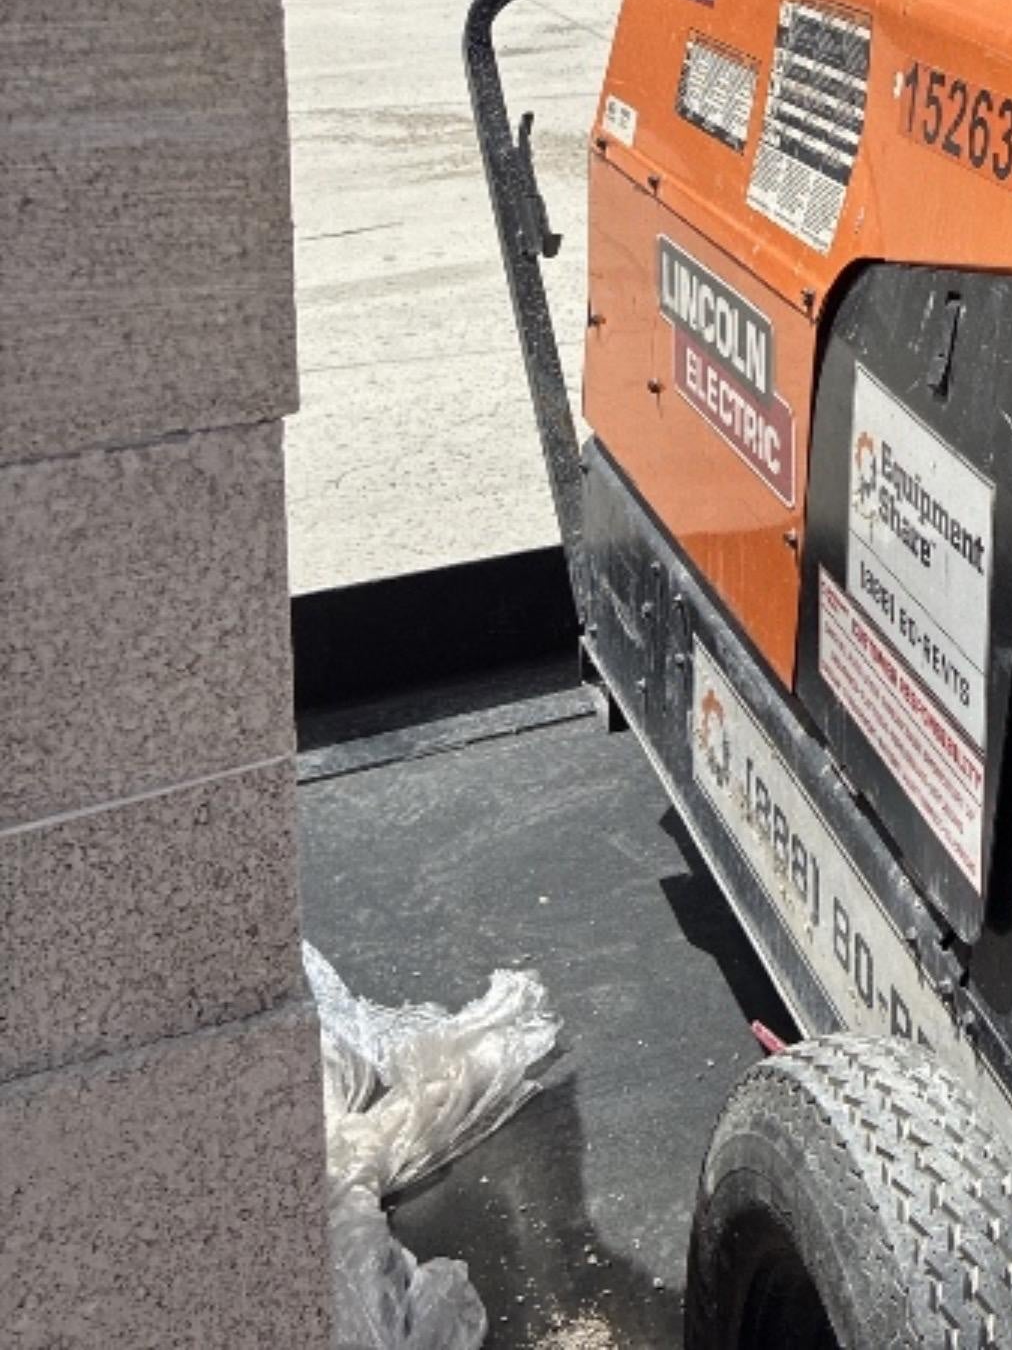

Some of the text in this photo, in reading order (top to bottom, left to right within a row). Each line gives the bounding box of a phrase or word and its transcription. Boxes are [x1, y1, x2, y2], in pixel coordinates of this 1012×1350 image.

[661, 251, 767, 394] LINCOLN
[685, 347, 781, 475] ELECTRIC
[879, 485, 931, 568] Share
[881, 440, 984, 575] Equipment
